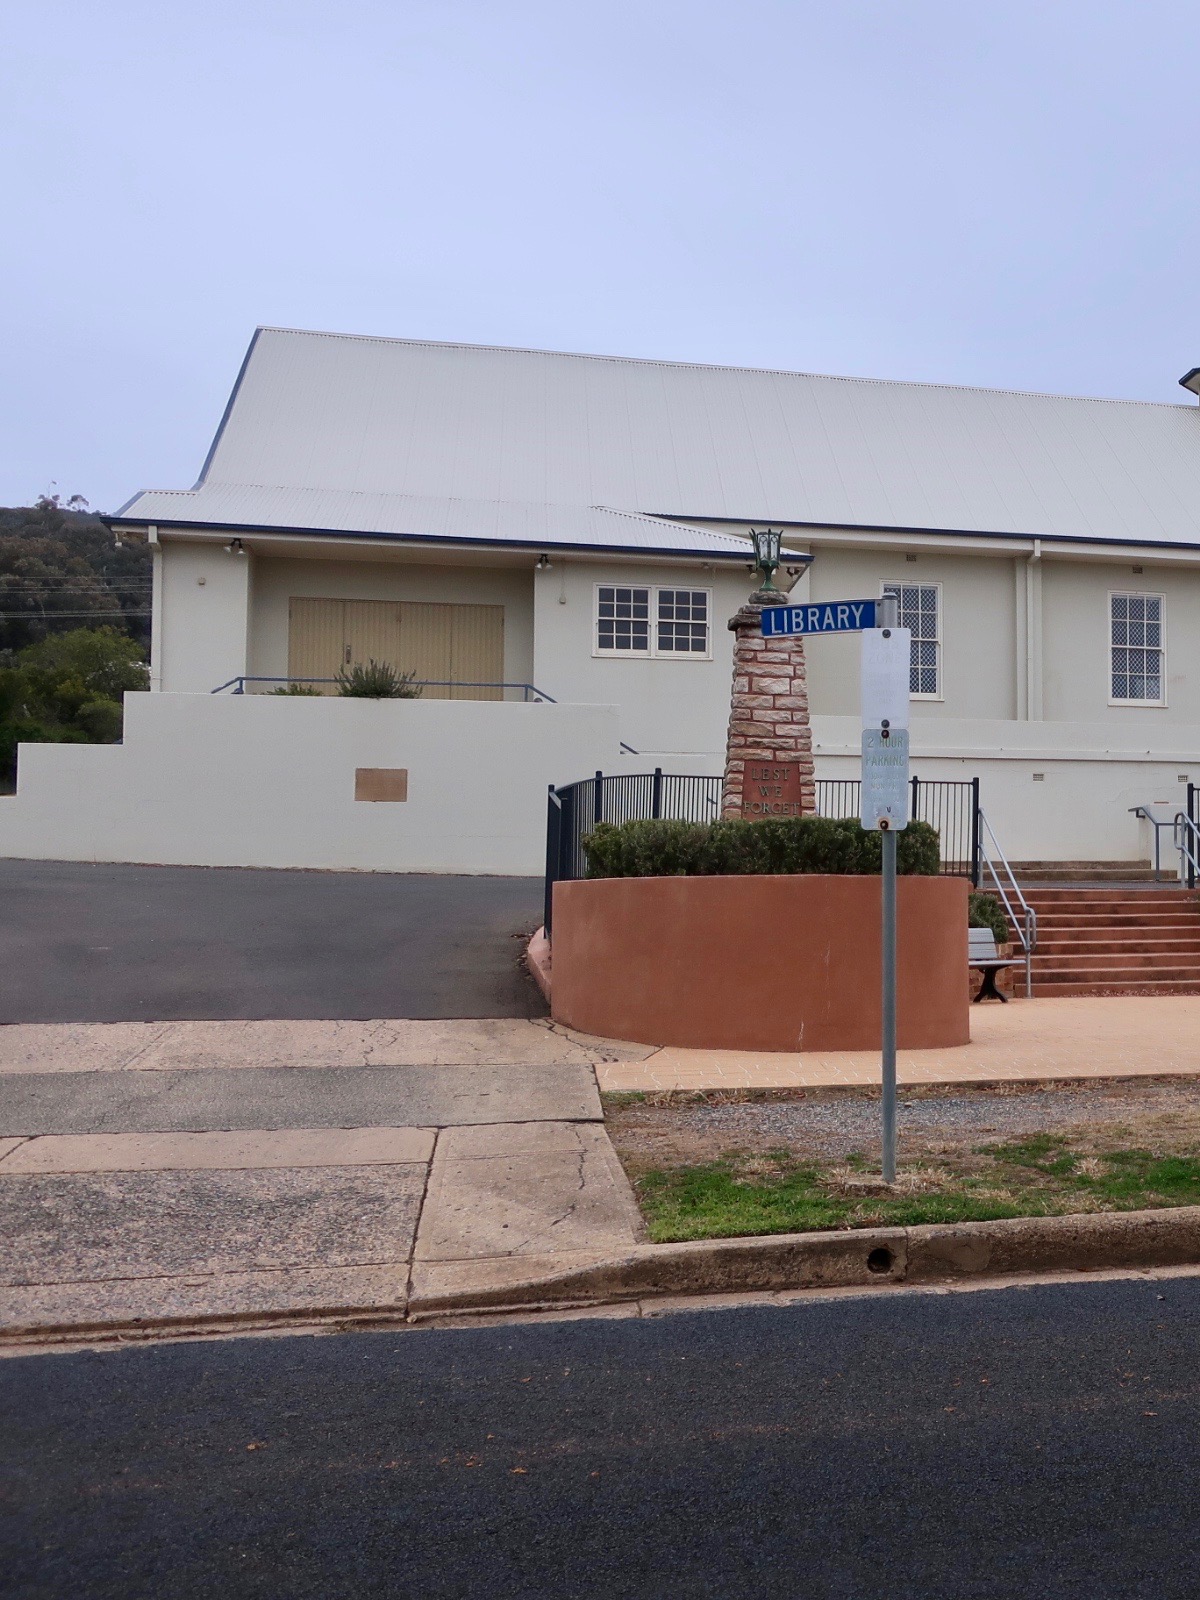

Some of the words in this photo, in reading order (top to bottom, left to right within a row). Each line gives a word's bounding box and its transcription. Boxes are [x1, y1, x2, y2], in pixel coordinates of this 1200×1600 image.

[770, 604, 865, 634] LIBRARY
[867, 737, 874, 749] 2
[879, 737, 903, 749] HOUR
[865, 755, 904, 767] PARKING
[751, 768, 790, 781] LEST
[757, 785, 783, 798] WE
[742, 802, 801, 816] FORGET
